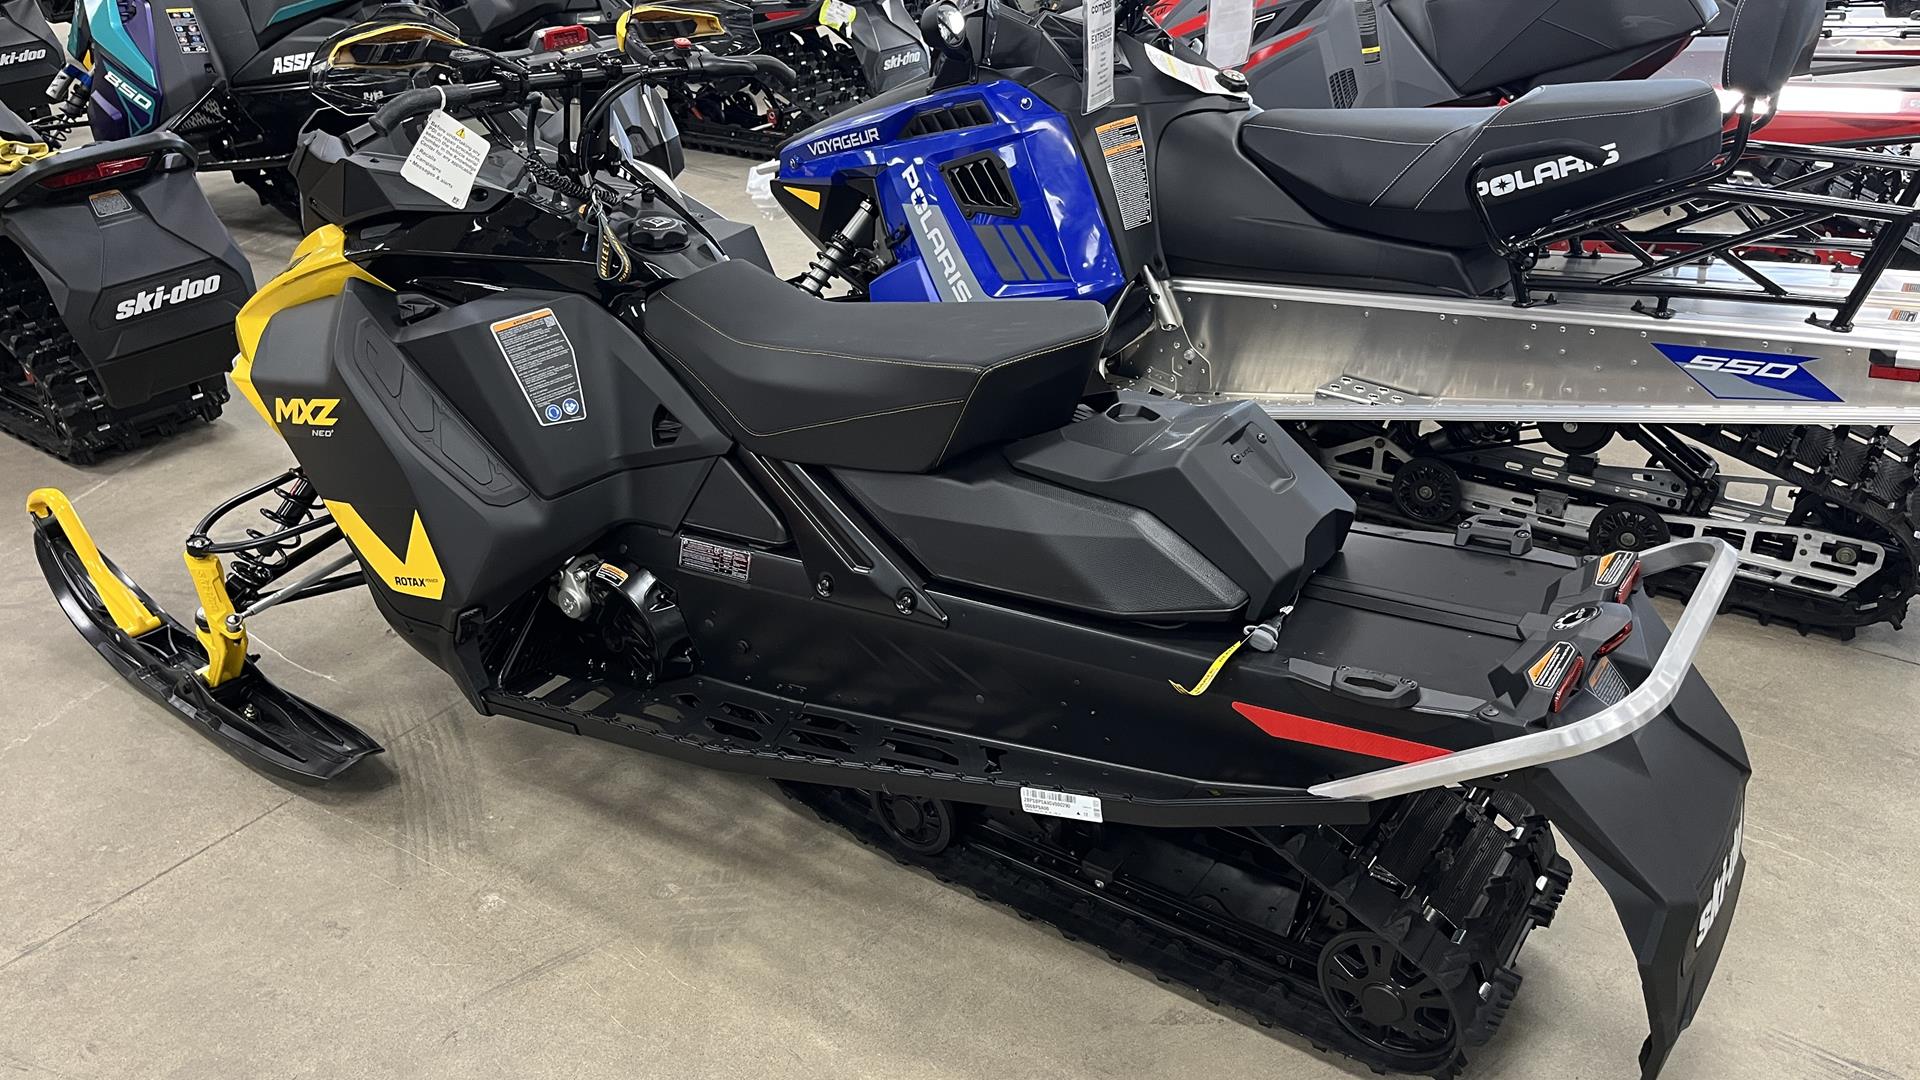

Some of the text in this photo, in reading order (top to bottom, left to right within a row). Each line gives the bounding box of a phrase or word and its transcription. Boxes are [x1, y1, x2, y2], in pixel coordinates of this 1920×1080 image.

[0, 49, 46, 65] ki-doo
[883, 51, 920, 70] ski-doo
[104, 71, 152, 110] 850
[431, 121, 446, 133] Before
[807, 128, 880, 155] VOYAGEUR
[415, 154, 441, 173] Campaigns
[419, 148, 436, 161] Recalls
[412, 161, 435, 177] Messages
[902, 163, 972, 302] POLARIS
[115, 274, 221, 320] ski-doo
[1683, 355, 1798, 379] 550
[275, 397, 340, 426] MXZ
[395, 576, 426, 587] ROTAX
